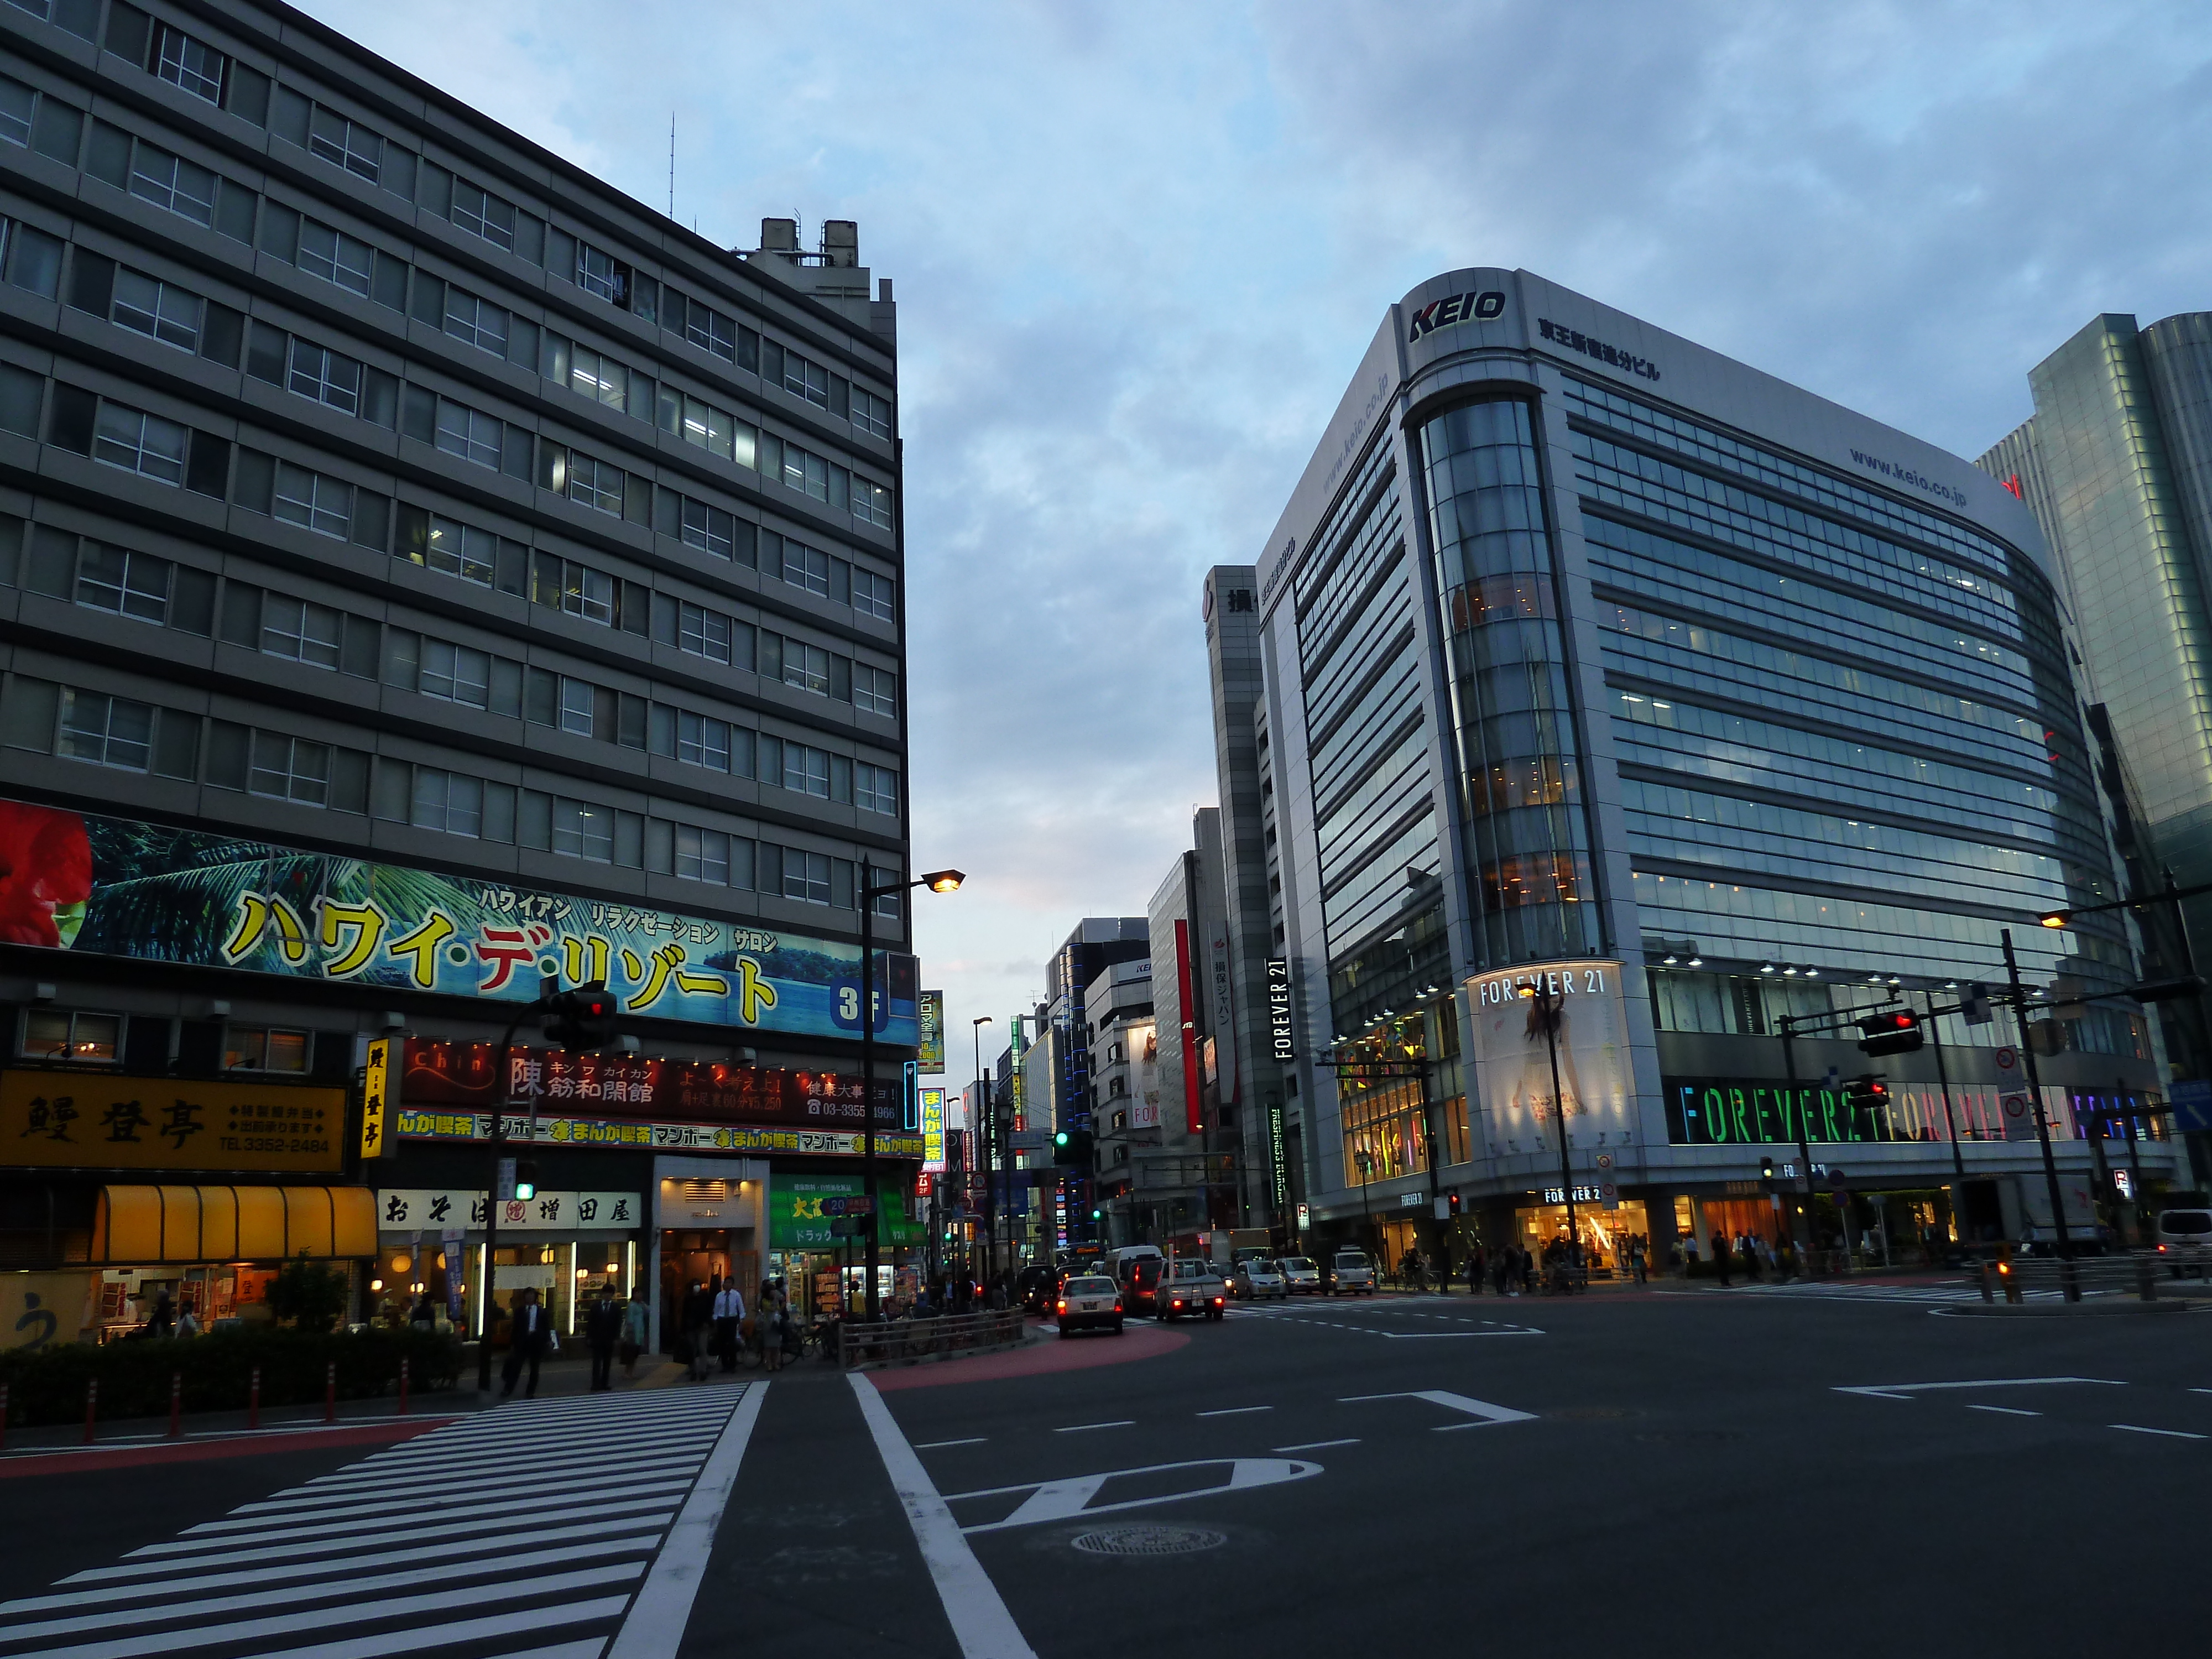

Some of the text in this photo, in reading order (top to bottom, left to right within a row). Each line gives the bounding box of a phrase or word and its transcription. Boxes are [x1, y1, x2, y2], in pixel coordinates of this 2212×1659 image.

[1410, 291, 1505, 343] KEIO
[1538, 317, 1660, 380] 京王新宿追分ビル
[1323, 373, 1389, 493] www.keio.co.jp
[1850, 449, 1966, 508] www.keio.co.jp
[1228, 589, 1257, 613] 損
[478, 887, 779, 953] ハワイアン リラクゼーション サロン
[1584, 969, 1604, 993] 21
[1268, 961, 1293, 1058] FOREVER 21
[414, 1052, 482, 1072] Chin
[573, 1123, 651, 1144] まんが喫茶
[654, 1126, 712, 1146] マンボー
[732, 1130, 799, 1150] まんが喫茶
[800, 1134, 851, 1152] マンボー
[924, 1091, 941, 1161] まんが喫茶
[1679, 1086, 1842, 1142] FOREVER
[539, 1198, 630, 1222] 増田屋
[831, 1198, 845, 1210] 20
[1545, 1190, 1594, 1203] FORVER
